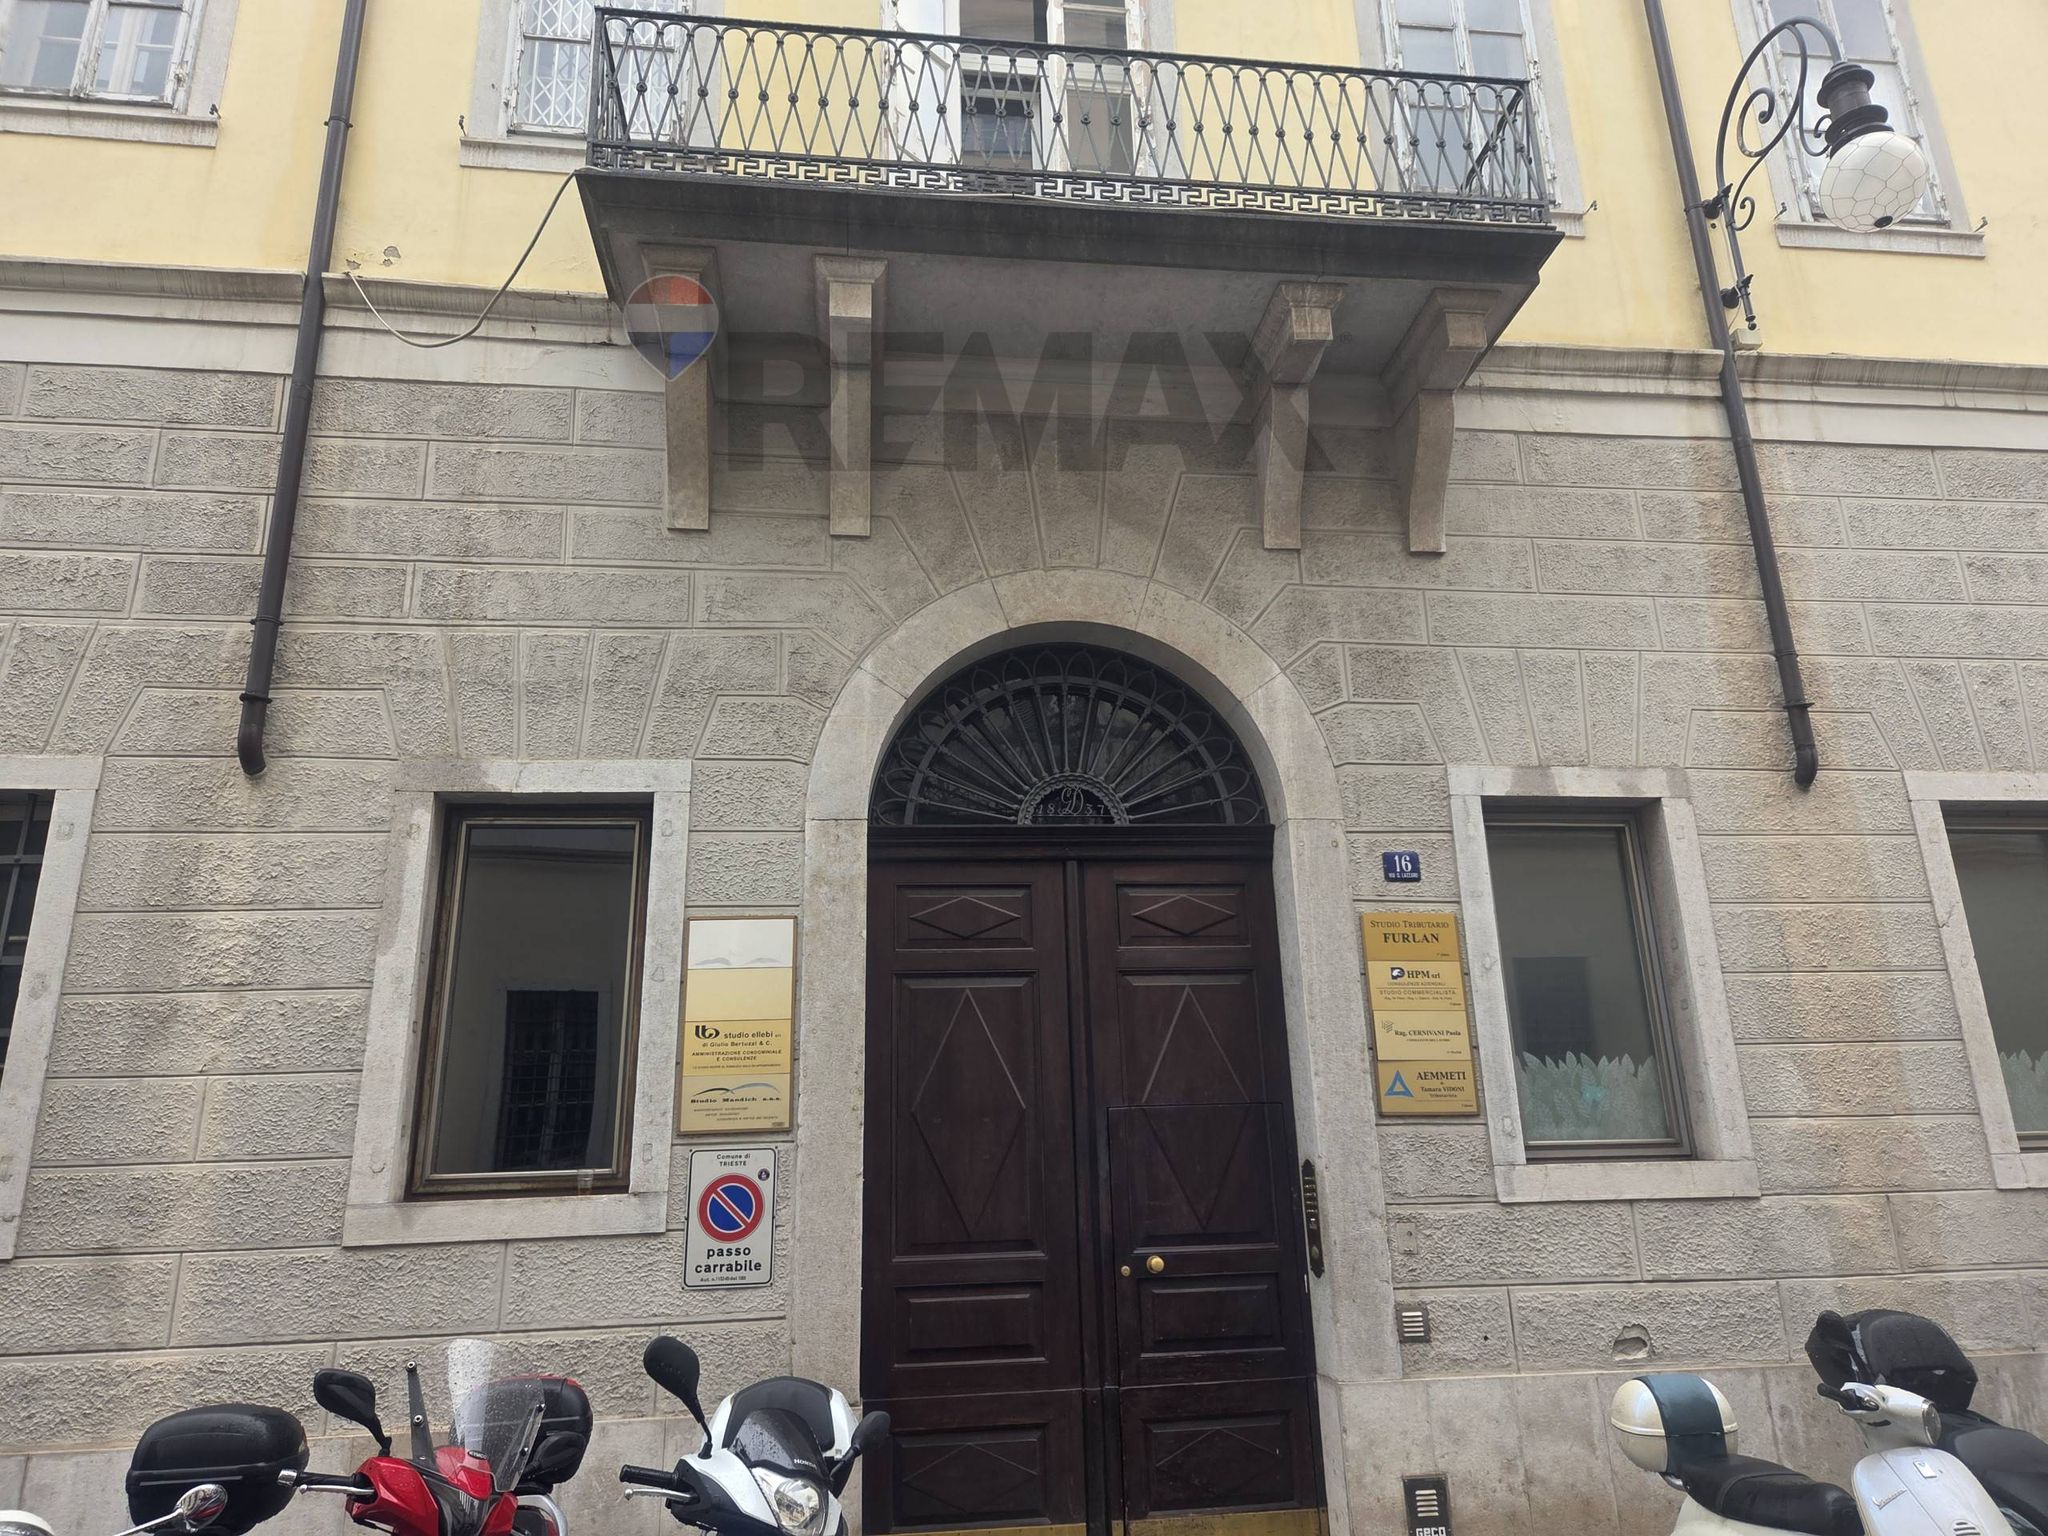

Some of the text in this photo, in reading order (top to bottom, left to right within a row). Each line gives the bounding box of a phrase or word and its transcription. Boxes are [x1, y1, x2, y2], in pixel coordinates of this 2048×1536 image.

[1394, 855, 1412, 873] 16
[1402, 920, 1449, 929] TRIBUTARIO
[1383, 932, 1440, 944] FURLAN
[1407, 970, 1430, 979] HPM
[724, 1032, 749, 1040] studio
[1416, 1071, 1466, 1080] AEMMETI
[706, 1247, 751, 1259] passo
[694, 1259, 762, 1273] carrabile
